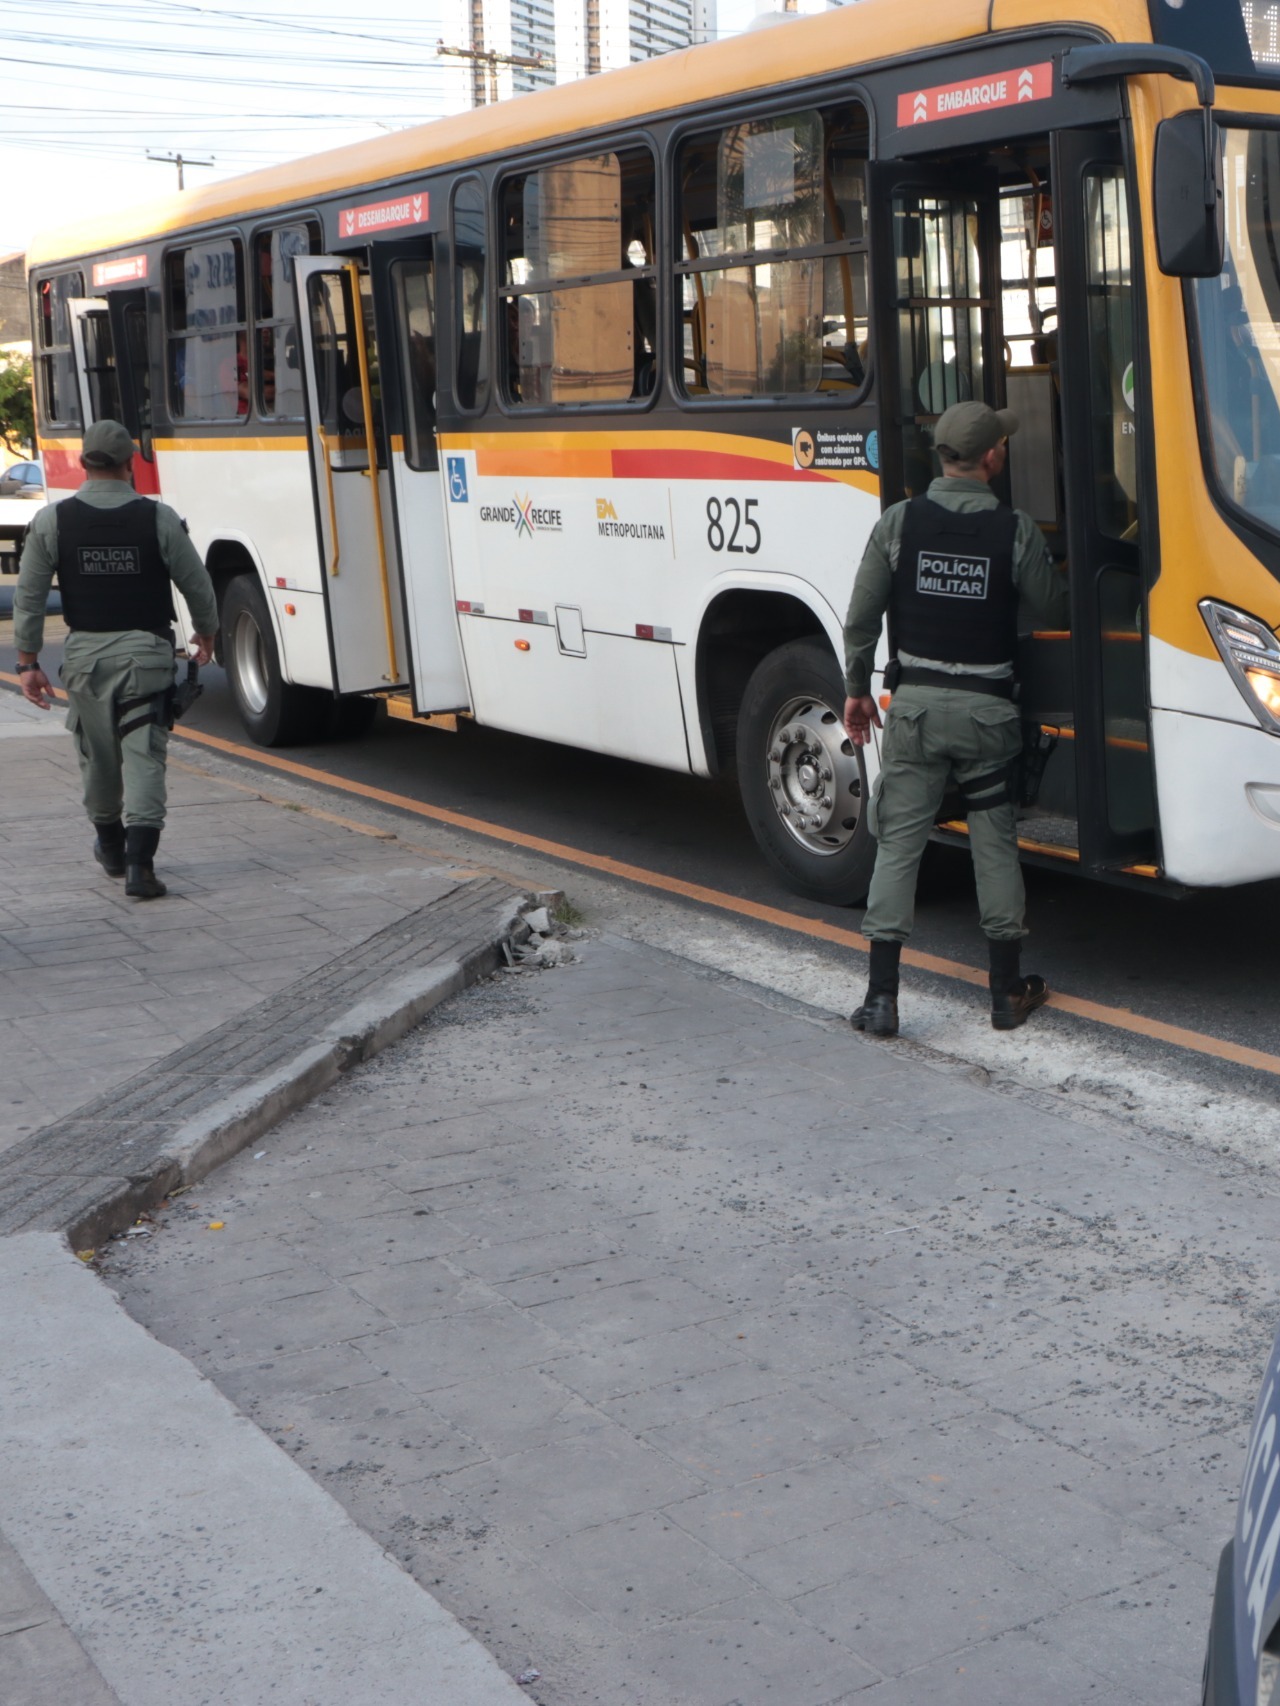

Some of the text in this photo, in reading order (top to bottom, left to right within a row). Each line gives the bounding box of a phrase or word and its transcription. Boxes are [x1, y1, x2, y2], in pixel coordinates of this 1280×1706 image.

[937, 80, 1007, 112] EMBARQUE
[357, 202, 410, 228] DESEMBARQUE
[816, 430, 863, 443] Ônibus equipado
[821, 444, 860, 454] com câmera e
[814, 456, 868, 467] rastreado por GPS.
[479, 506, 562, 526] GRANDE RECIFE
[598, 522, 665, 540] METROPOLITANA
[706, 496, 761, 555] 825
[82, 548, 135, 562] POLÍCIA
[83, 561, 136, 573] MILITAR
[920, 559, 985, 578] POLÍCIA
[919, 576, 983, 595] MILITAR
